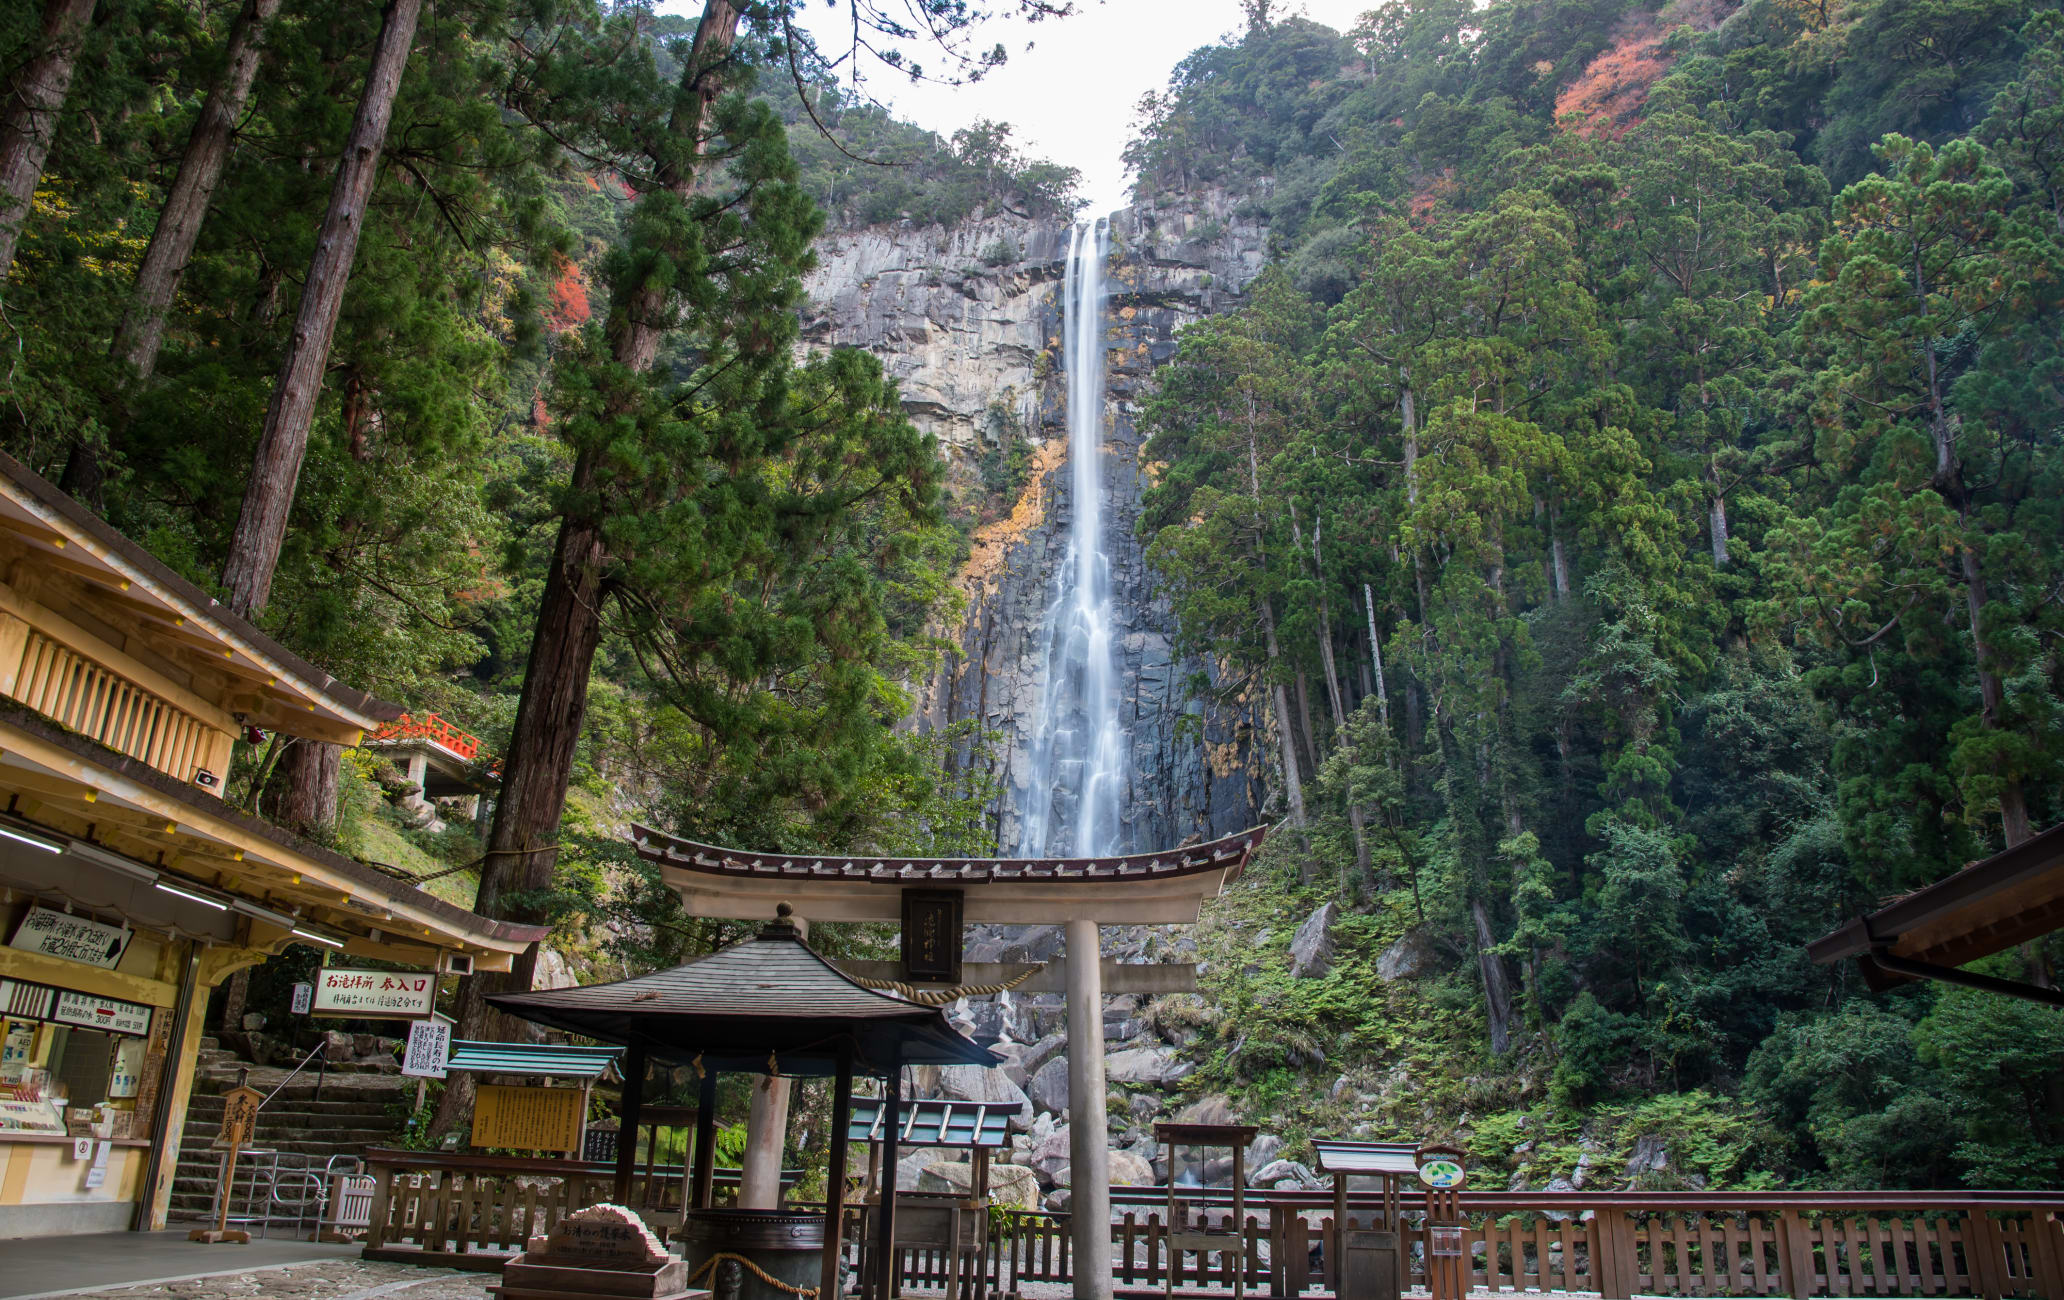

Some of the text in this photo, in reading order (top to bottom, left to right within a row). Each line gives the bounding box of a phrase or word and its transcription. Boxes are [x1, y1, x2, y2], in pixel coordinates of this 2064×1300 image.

[379, 976, 427, 992] 参入口
[18, 1038, 31, 1047] AED
